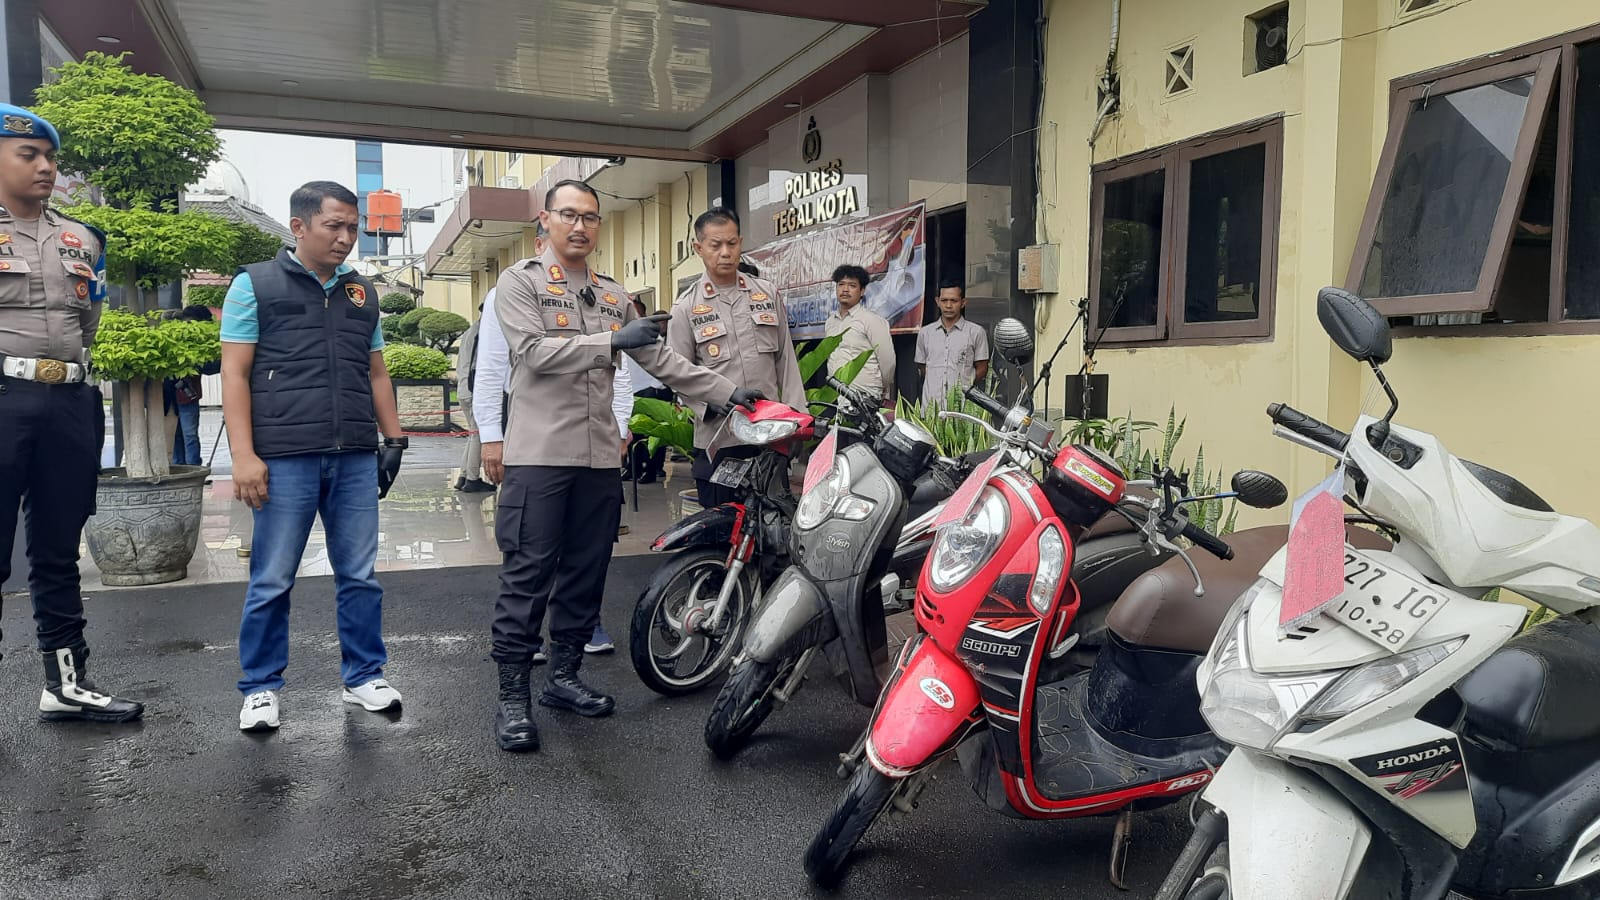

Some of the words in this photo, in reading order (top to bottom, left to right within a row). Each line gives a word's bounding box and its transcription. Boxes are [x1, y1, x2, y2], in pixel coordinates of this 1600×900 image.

[784, 159, 842, 203] POLRES
[772, 202, 815, 236] TEGAL
[816, 186, 858, 221] KOTA
[541, 298, 562, 308] HERU
[600, 306, 623, 319] POLRI
[750, 302, 775, 312] POLRI
[1393, 587, 1438, 619] IG
[962, 637, 1022, 657] SCOOPY
[927, 680, 953, 703] YSS
[1376, 745, 1452, 770] HONDA
